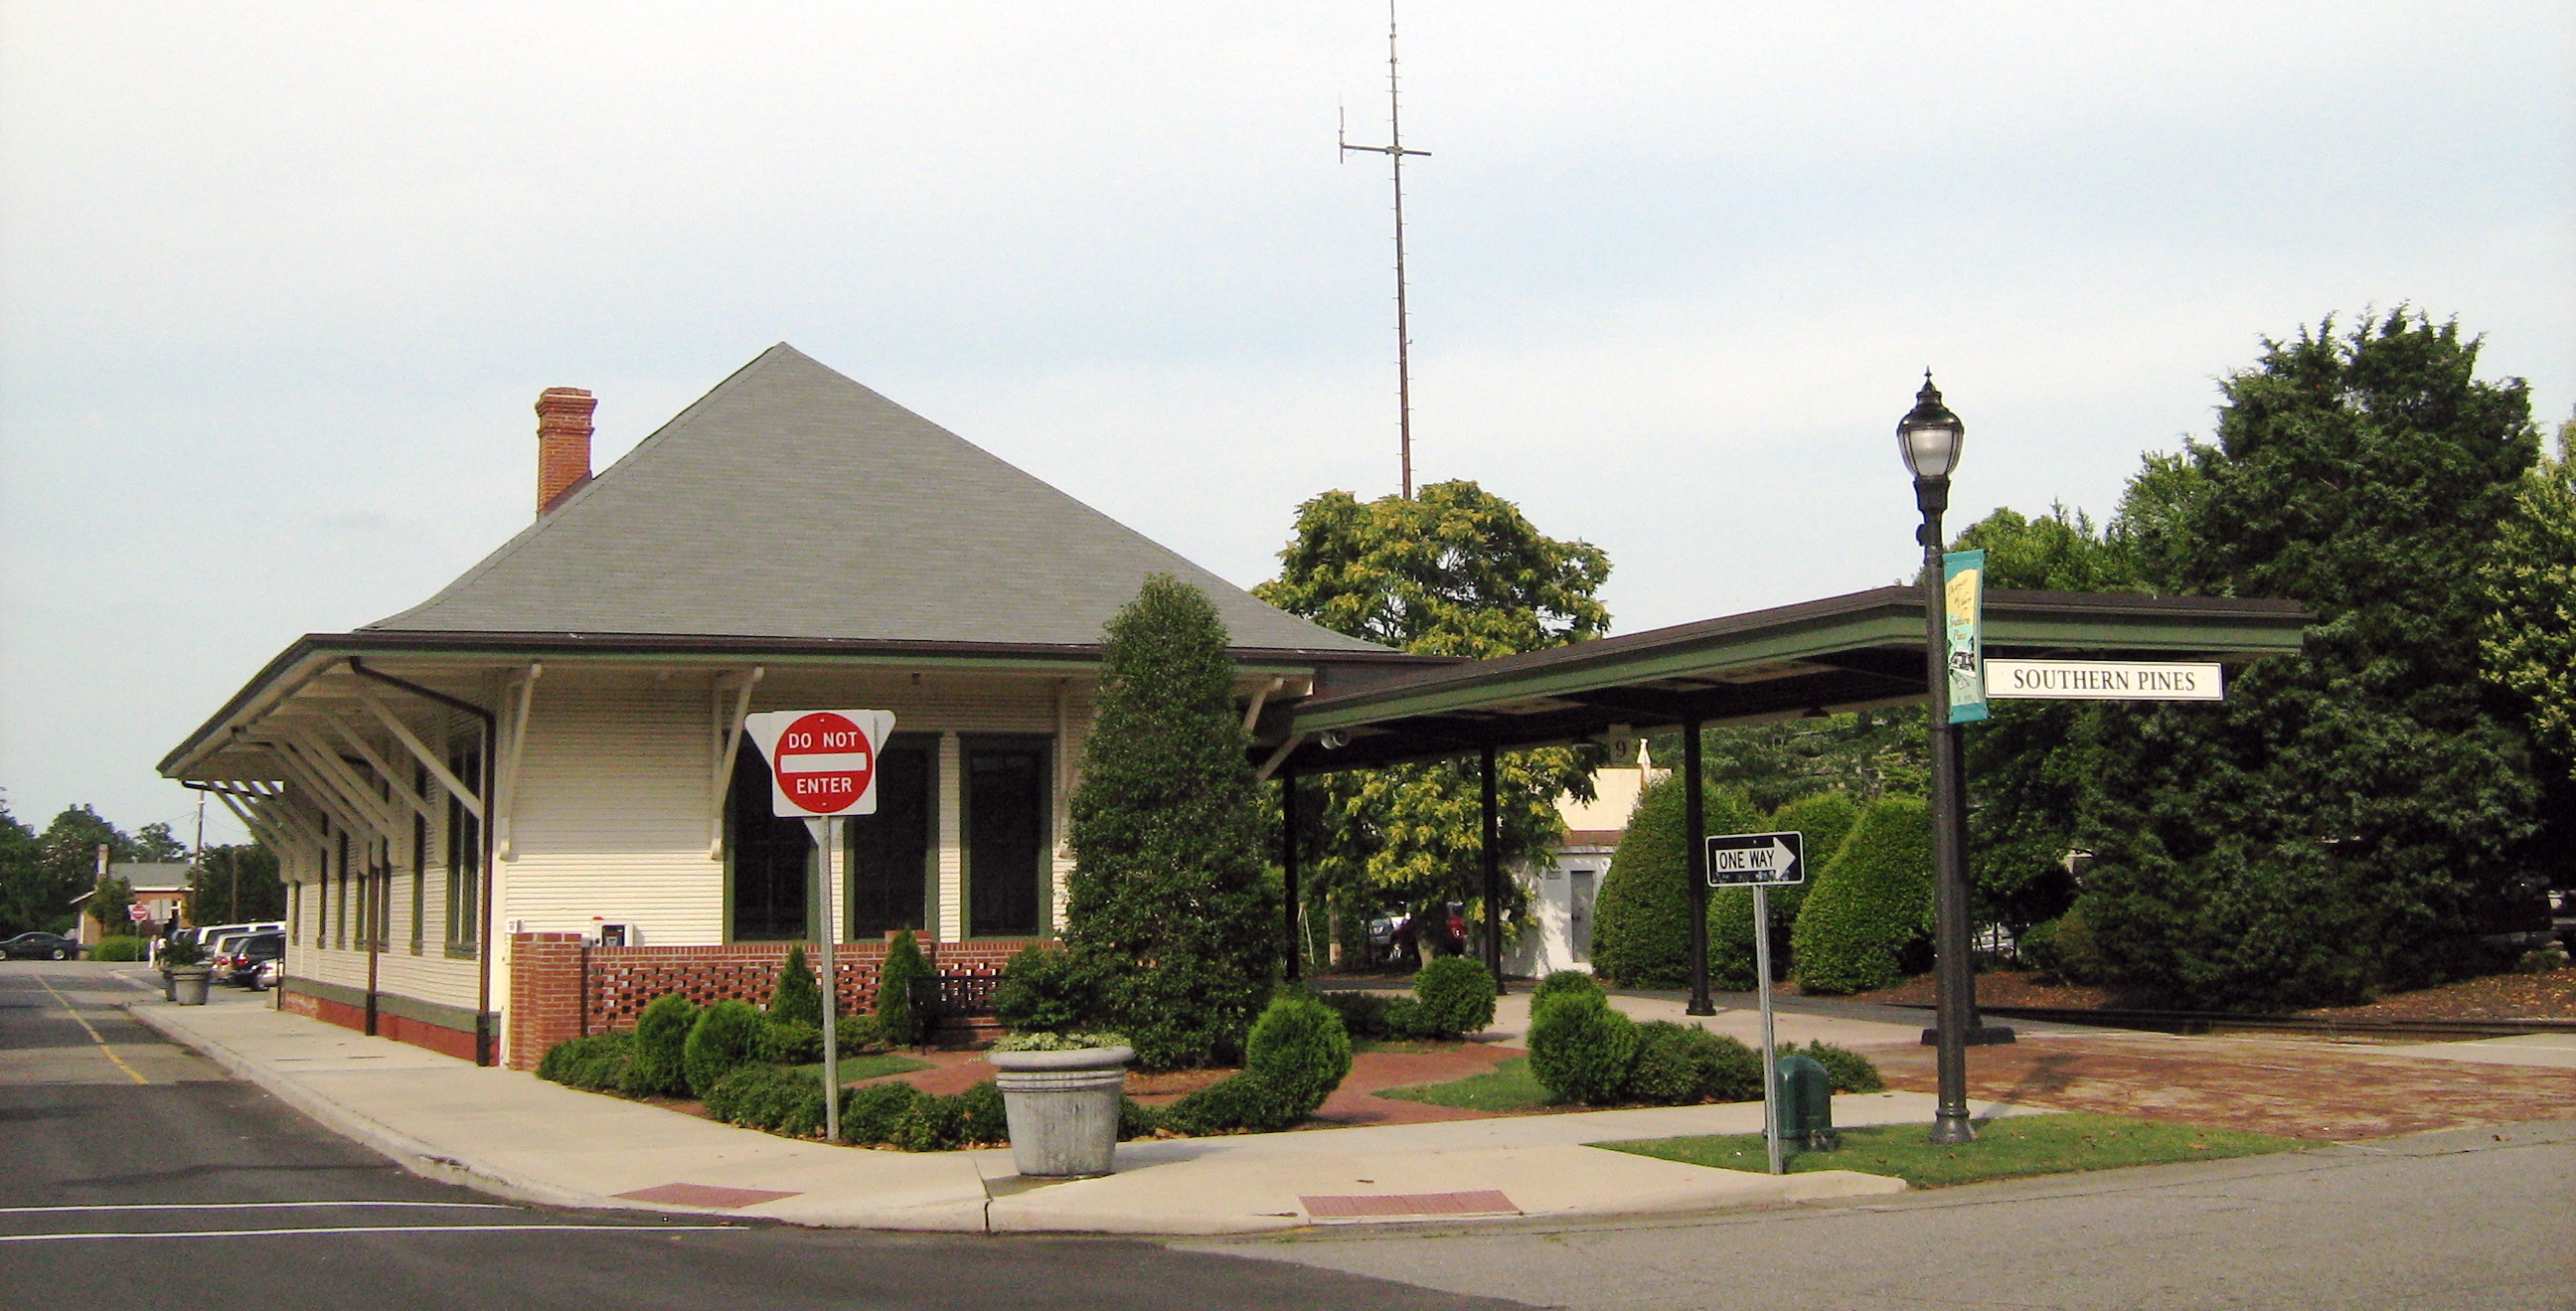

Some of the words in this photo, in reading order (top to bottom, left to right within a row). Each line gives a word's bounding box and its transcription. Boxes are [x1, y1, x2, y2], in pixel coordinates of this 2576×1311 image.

[2013, 668, 2130, 691] SOUTHERN
[2137, 670, 2196, 692] PINES
[788, 733, 812, 748] DO
[823, 731, 858, 747] NOT
[1615, 740, 1627, 757] 9
[796, 776, 853, 794] ENTER
[1719, 851, 1745, 870] ONE
[1749, 850, 1774, 869] WAY
